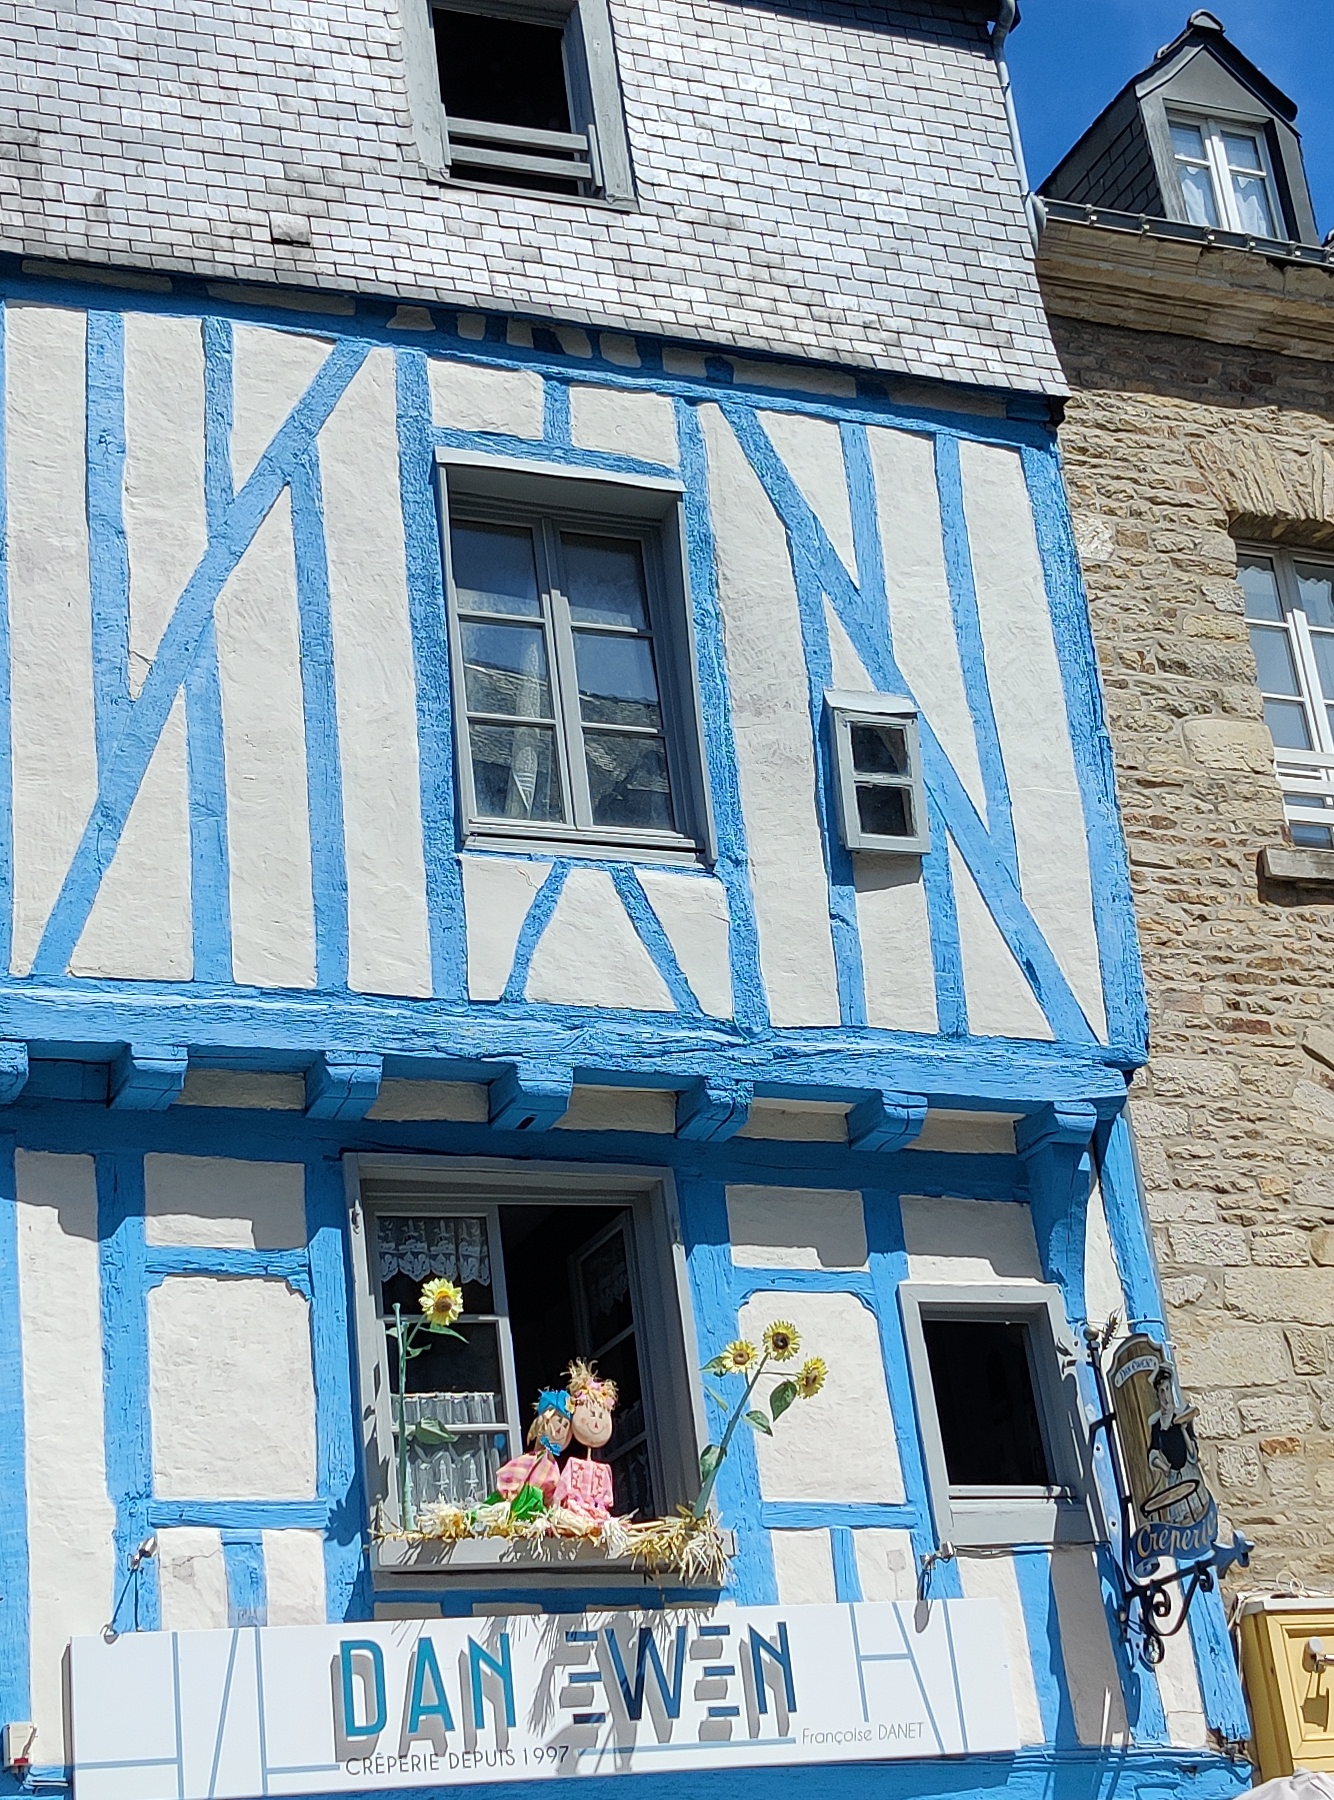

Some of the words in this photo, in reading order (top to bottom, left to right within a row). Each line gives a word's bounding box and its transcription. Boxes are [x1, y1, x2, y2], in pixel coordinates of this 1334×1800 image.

[339, 1632, 517, 1737] DAN
[564, 1621, 798, 1722] EWEN
[802, 1726, 873, 1746] Françoise
[877, 1721, 925, 1741] DANET
[345, 1752, 440, 1776] CRÊPERIE
[448, 1748, 516, 1770] DEPUIS
[523, 1745, 570, 1765] 1997
